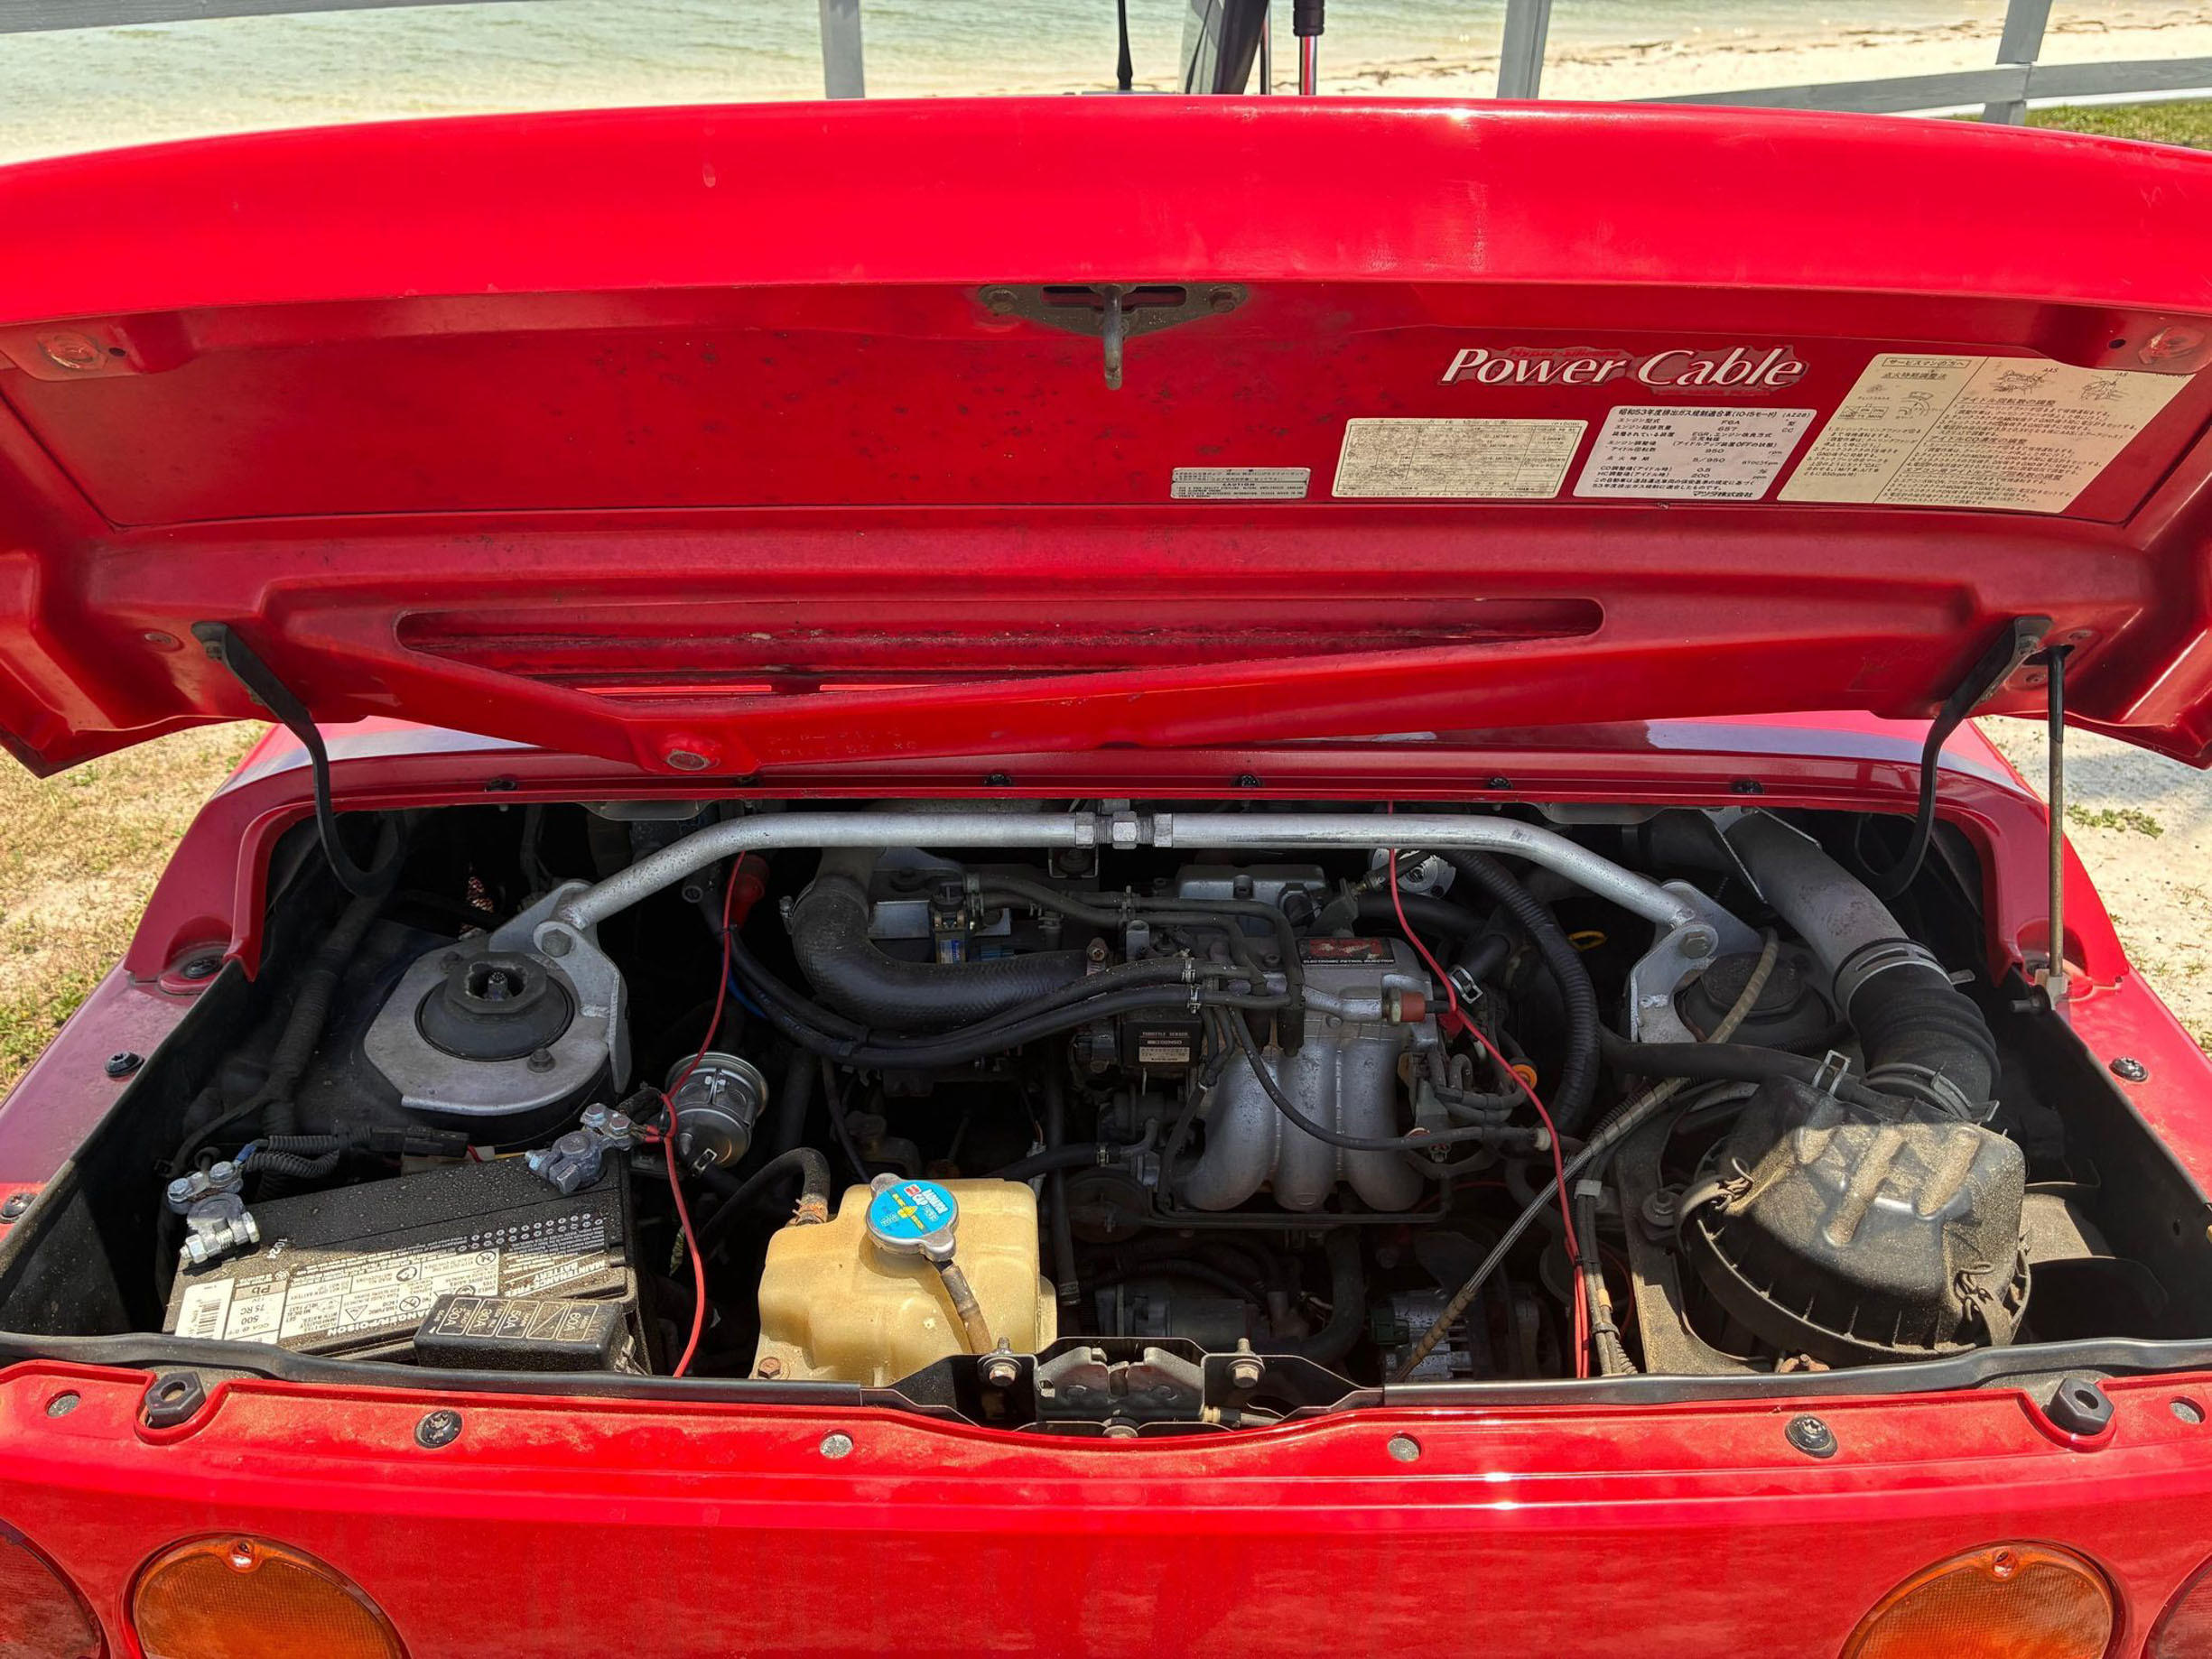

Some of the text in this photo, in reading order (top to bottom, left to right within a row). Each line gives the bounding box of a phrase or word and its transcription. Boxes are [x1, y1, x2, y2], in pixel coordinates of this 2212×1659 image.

[1441, 347, 1804, 385] Power Cable
[251, 1284, 271, 1295] Pb
[240, 1315, 259, 1326] 500
[443, 1307, 463, 1327] 30A
[473, 1309, 493, 1328] 30A
[503, 1310, 522, 1330] 50A
[563, 1312, 582, 1332] 60A
